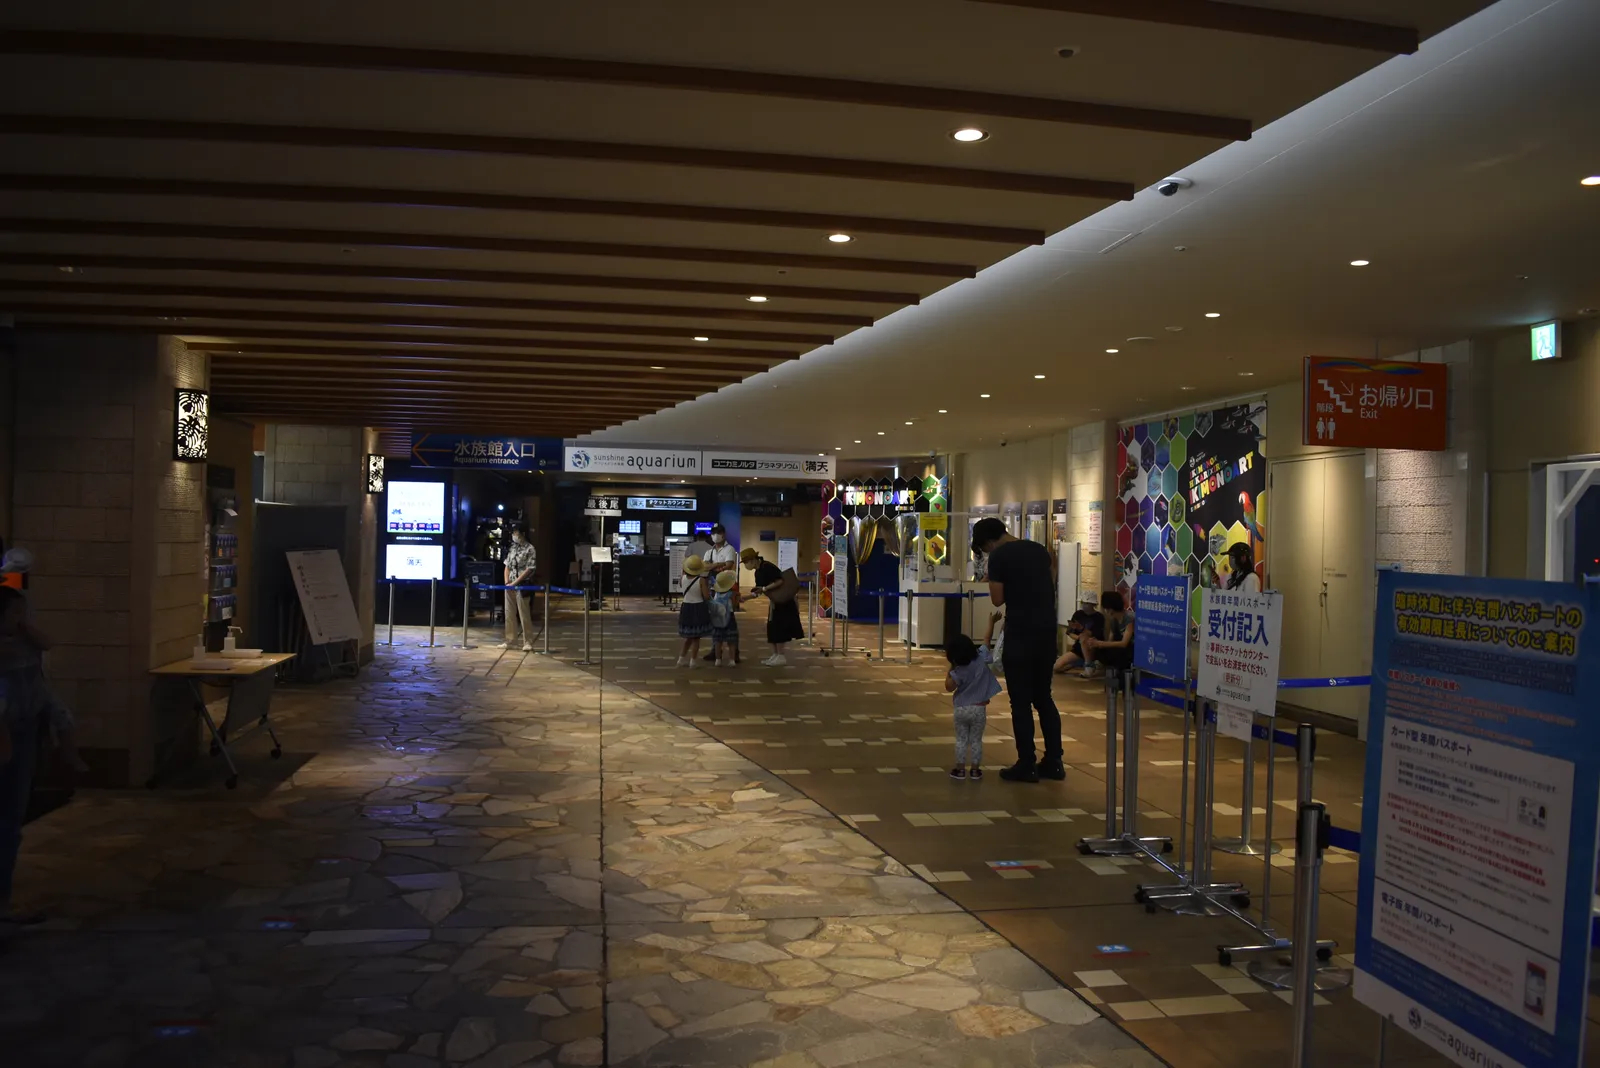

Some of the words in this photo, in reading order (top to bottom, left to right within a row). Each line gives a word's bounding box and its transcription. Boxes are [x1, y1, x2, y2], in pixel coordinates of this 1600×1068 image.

[1359, 384, 1434, 410] お帰り口
[1360, 408, 1378, 419] Exit
[454, 438, 536, 458] 水族館入口
[454, 457, 488, 465] Aquarium
[594, 454, 625, 462] sunshine
[627, 454, 696, 471] aquarium
[713, 460, 756, 469] コニカミノルタ
[758, 461, 799, 470] プラネタリウム
[805, 460, 829, 472] 満天
[1188, 449, 1255, 505] IKIMONOART
[587, 499, 619, 509] 最後尾
[1210, 595, 1272, 610] 水族館年間パスポート
[1395, 591, 1582, 628] 臨時休館に伴う年間パスポートの
[1208, 609, 1269, 647] 受付記入
[1397, 614, 1576, 656] 有効期限延長についてのご案内
[1391, 725, 1418, 743] カード型
[1420, 731, 1473, 756] 年間パスポート
[1381, 891, 1403, 911] 電子版
[1404, 902, 1455, 934] 年間パスポート
